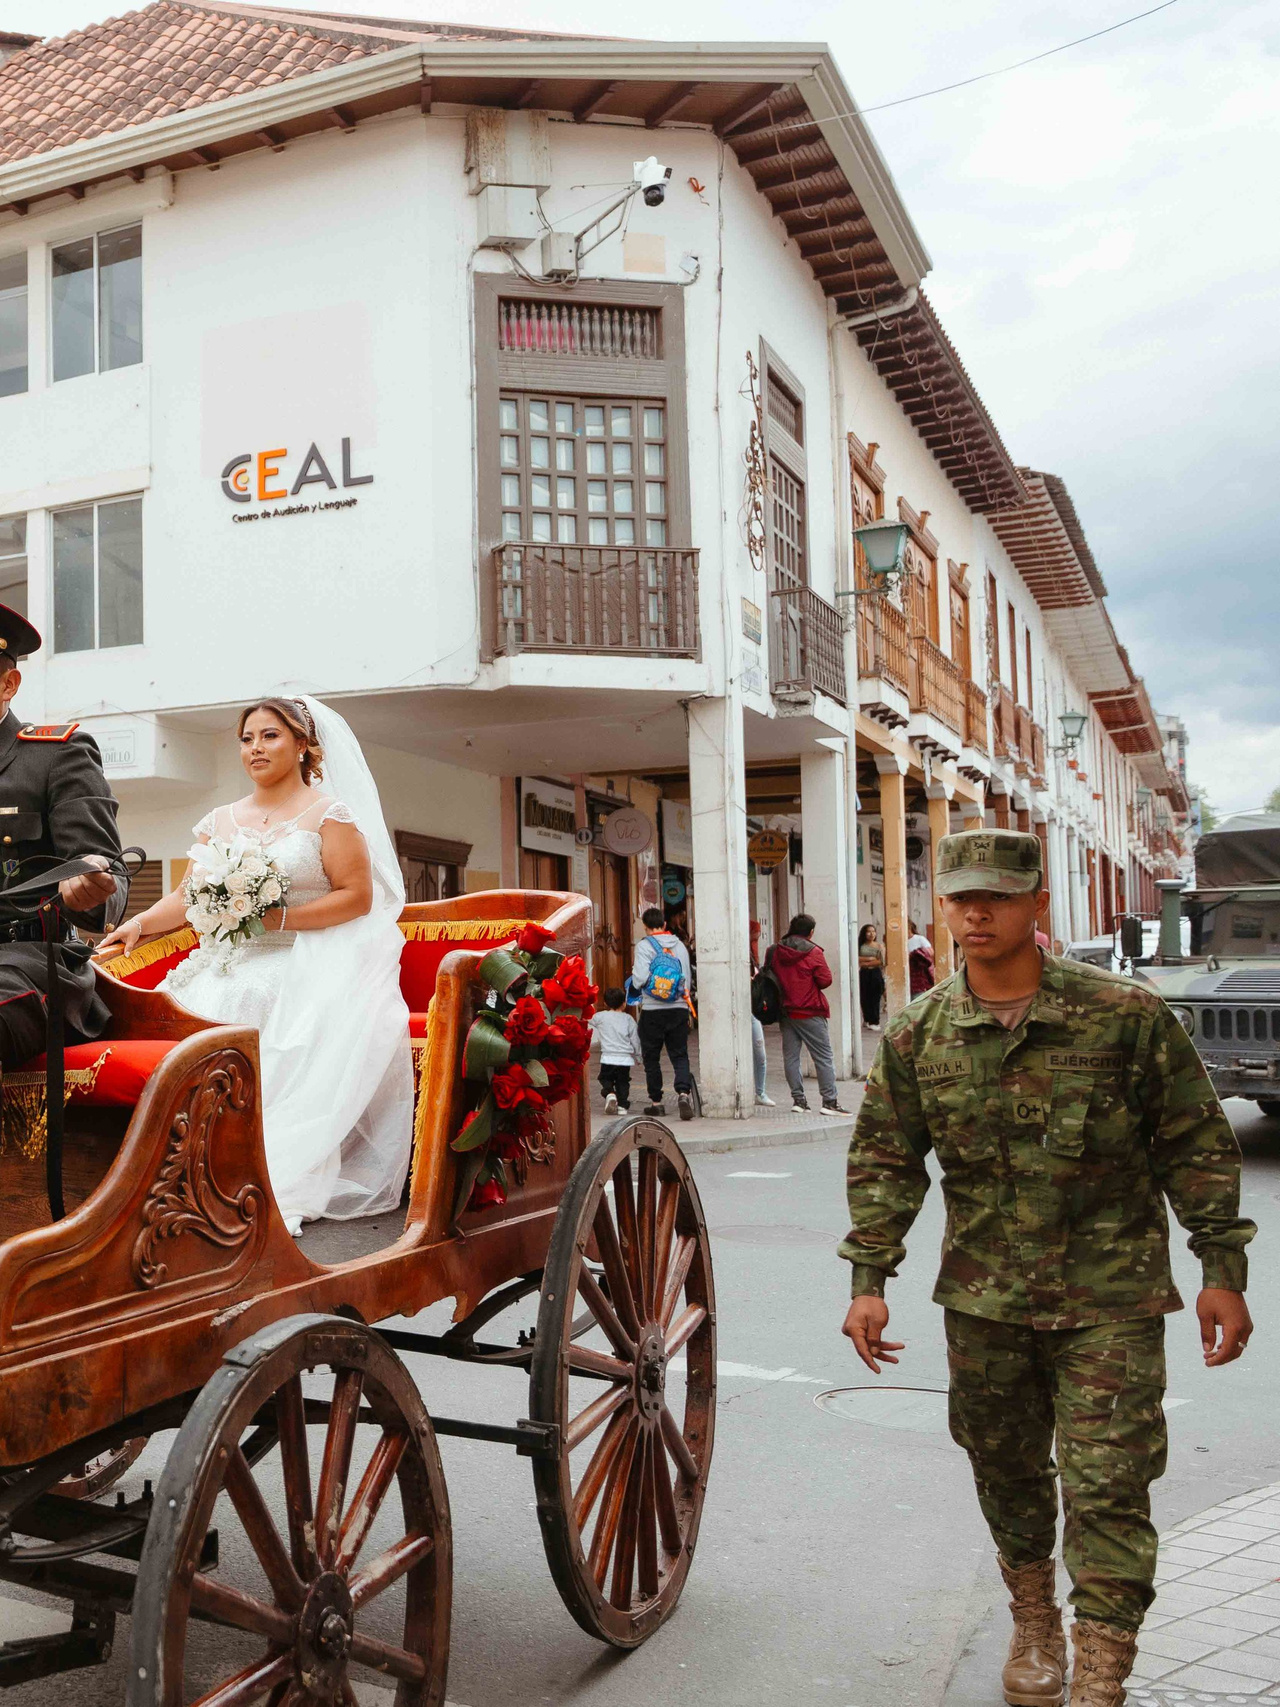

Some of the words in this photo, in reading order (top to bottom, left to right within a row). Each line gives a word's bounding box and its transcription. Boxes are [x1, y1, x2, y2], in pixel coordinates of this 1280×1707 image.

[221, 437, 374, 503] CEAL
[232, 512, 259, 524] Centro
[261, 509, 271, 520] de
[273, 503, 310, 517] Audición
[311, 504, 318, 514] y
[319, 496, 359, 511] Lenguaje
[955, 1060, 965, 1072] H.
[1050, 1053, 1121, 1067] EJÉRCITO
